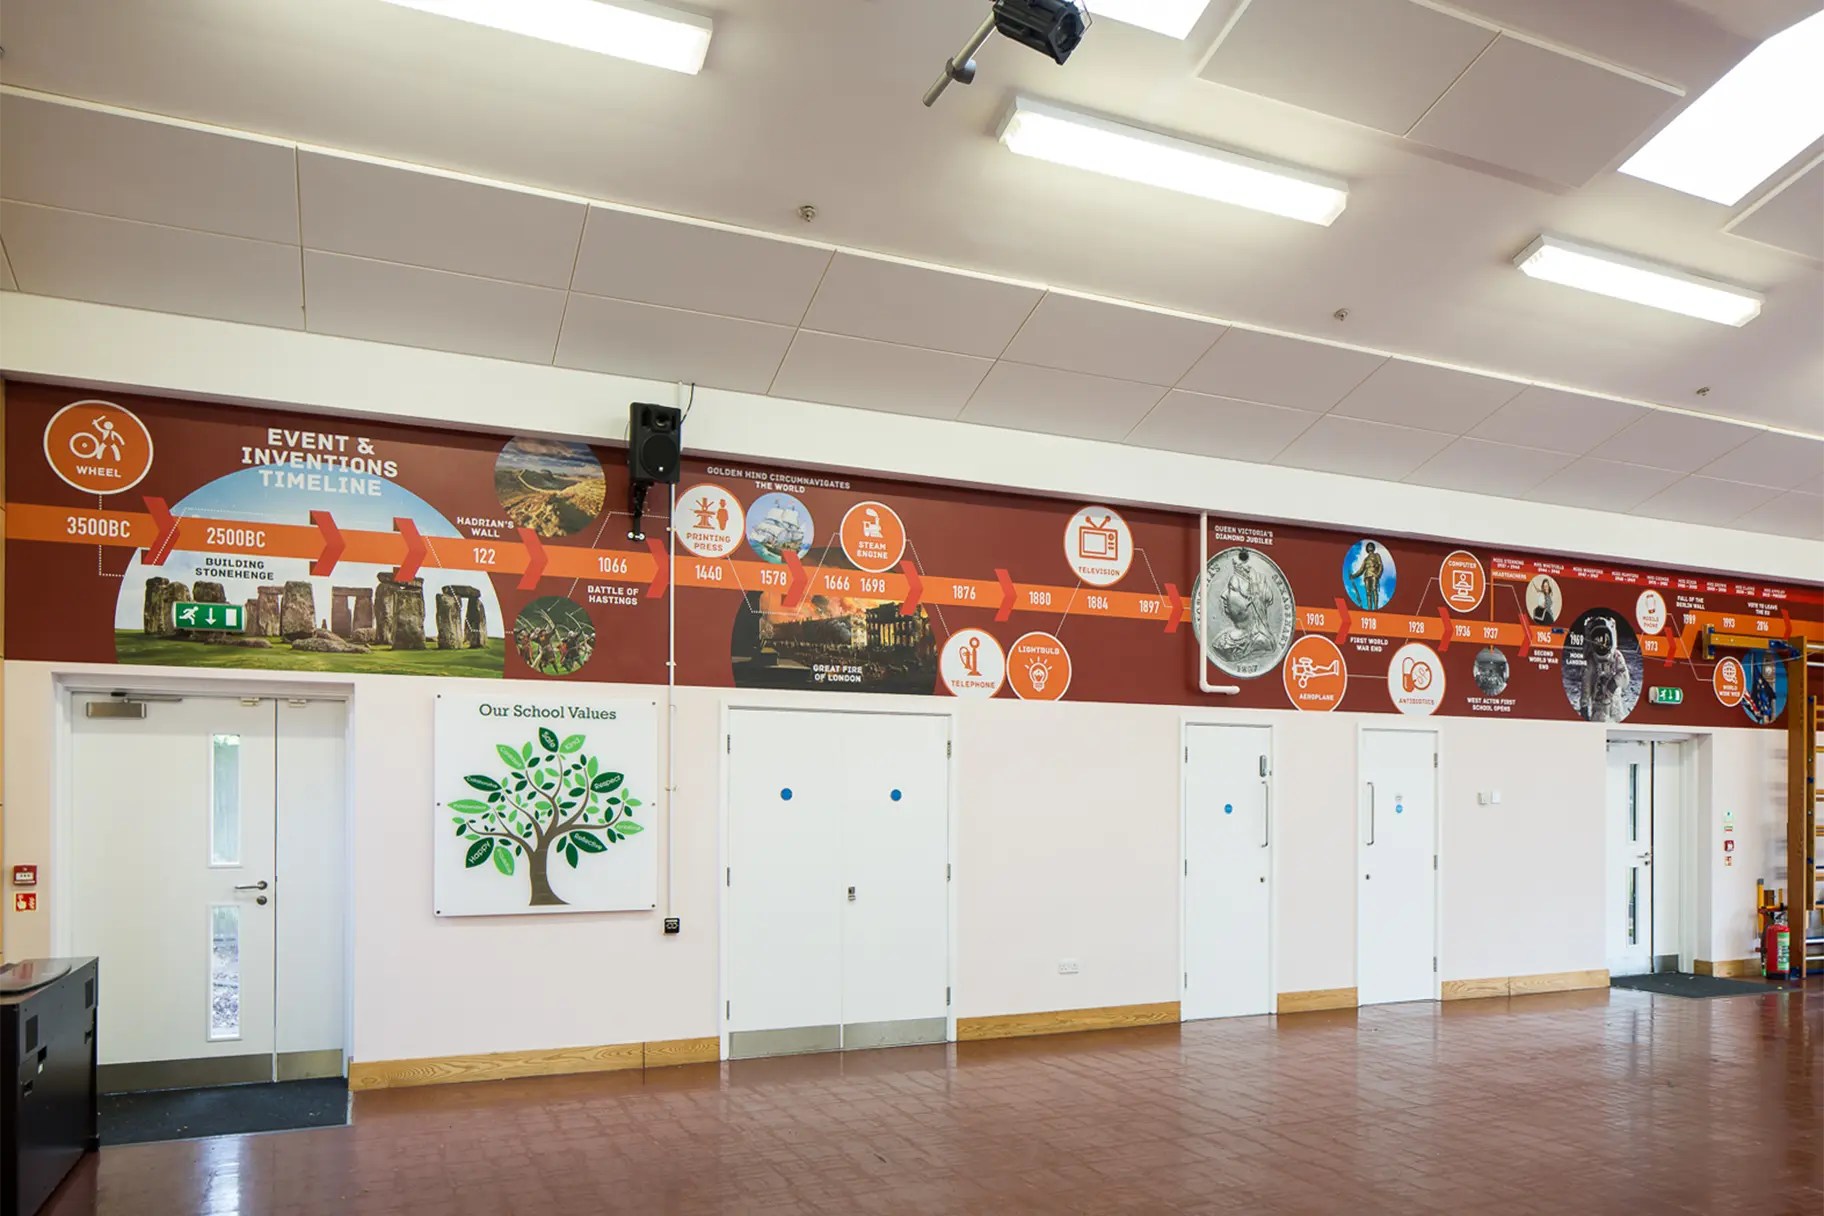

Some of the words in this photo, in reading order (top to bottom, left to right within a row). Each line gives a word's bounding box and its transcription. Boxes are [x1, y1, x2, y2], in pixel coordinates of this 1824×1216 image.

[268, 428, 350, 452] EVENT
[357, 437, 375, 455] &
[242, 447, 398, 478] INVENTIONS
[76, 464, 122, 478] WHEEL
[258, 470, 382, 496] TIMELINE
[707, 466, 742, 478] GOLDEN
[744, 471, 768, 480] HIND
[770, 472, 850, 490] CIRCUMNAVIGATES
[755, 481, 773, 490] THE
[775, 482, 805, 494] WORLD
[66, 516, 130, 538] 3500BC
[456, 516, 514, 529] HADRIAN'S
[206, 528, 266, 548] 2500BC
[472, 528, 500, 538] WALL
[686, 532, 731, 543] PRINTING
[1215, 533, 1245, 542] DIAMOND
[1246, 536, 1273, 545] JUBILEE
[1237, 528, 1273, 537] VICTORIA'S
[694, 542, 724, 552] PRESS
[858, 540, 886, 550] STEAM
[473, 548, 496, 564] 122
[856, 550, 888, 560] ENGINE
[206, 558, 264, 570] BUILDING
[598, 557, 628, 574] 1066
[1448, 561, 1476, 569] COMPUTER
[196, 568, 274, 580] STONEHENGE
[695, 565, 722, 581] 1440
[760, 569, 787, 586] 1578
[1078, 566, 1120, 576] TELEVISION
[824, 575, 850, 591] 1666
[860, 578, 885, 593] 1698
[588, 585, 623, 595] BATTLE
[626, 588, 639, 596] OF
[952, 585, 976, 600] 1876
[588, 595, 638, 606] HASTINGS
[1029, 591, 1051, 606] 1880
[1087, 596, 1108, 610] 1884
[1139, 600, 1160, 614] 1897
[1306, 613, 1325, 626] 1903
[1361, 617, 1377, 630] 1918
[1409, 621, 1425, 633] 1928
[1455, 625, 1470, 637] 1936
[1483, 627, 1498, 639] 1937
[1537, 632, 1551, 643] 1945
[1570, 634, 1584, 645] 1969
[1018, 646, 1060, 655] LIGHTBULB
[1644, 640, 1658, 651] 1973
[813, 664, 840, 674] GREAT
[842, 665, 862, 674] FIRE
[814, 673, 826, 682] OF
[828, 674, 861, 683] LONDON
[951, 680, 995, 689] TELEPHONE
[478, 704, 509, 717] Our
[514, 704, 564, 718] School
[568, 706, 617, 720] Values
[542, 731, 556, 748] Safe
[564, 737, 580, 750] Kind
[594, 775, 621, 790] Respect
[574, 832, 602, 850] Reflective
[468, 841, 491, 864] Happy
